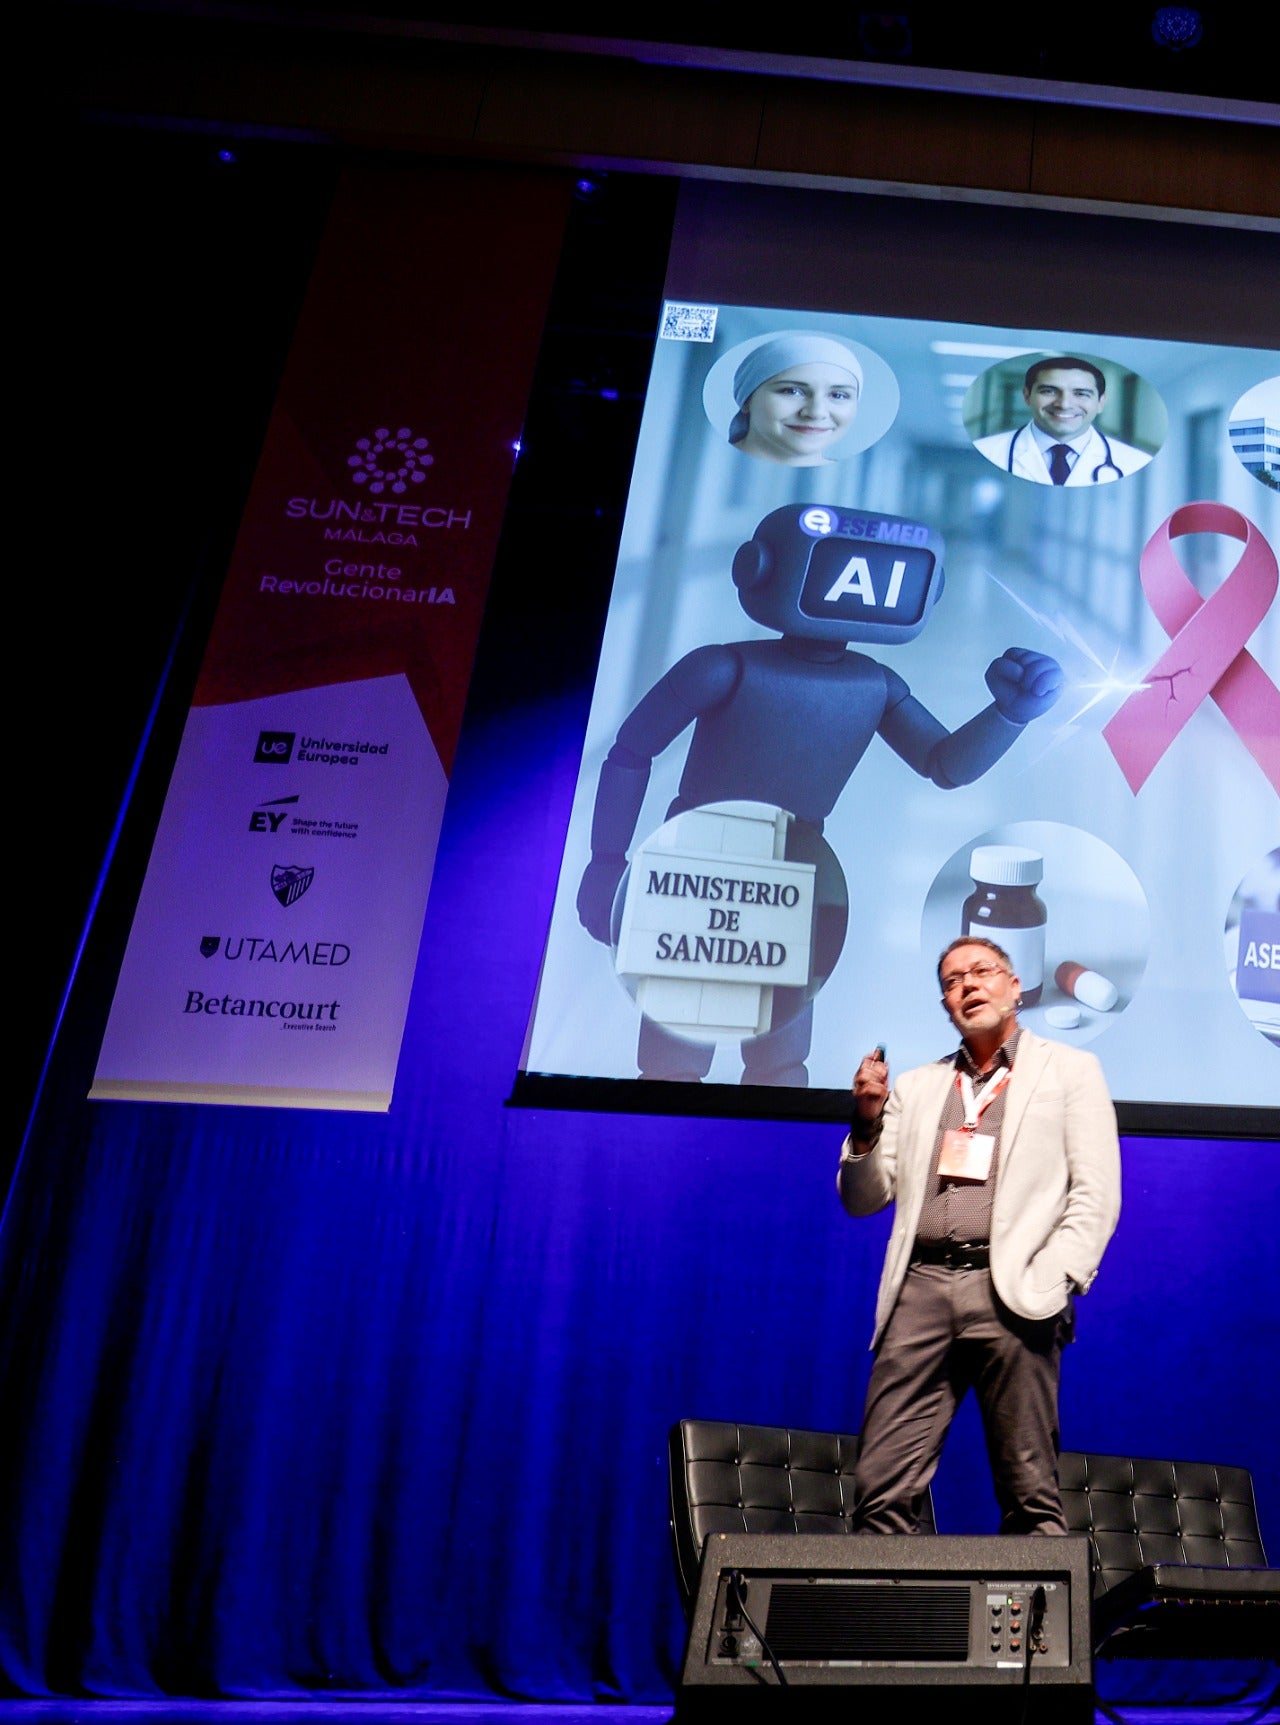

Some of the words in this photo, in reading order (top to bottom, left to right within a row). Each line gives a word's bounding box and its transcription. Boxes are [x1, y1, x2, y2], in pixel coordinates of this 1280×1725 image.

[285, 497, 472, 530] SUN&TECH
[838, 515, 929, 545] ESEMED
[324, 558, 402, 580] Gente
[824, 556, 906, 608] AI
[260, 575, 456, 605] RevolucionarIA
[297, 749, 359, 765] Europea
[301, 737, 389, 755] Universidad
[249, 811, 288, 832] EY
[291, 826, 310, 836] with
[311, 828, 357, 839] confidence
[293, 818, 318, 829] Shape
[319, 819, 333, 829] the
[335, 821, 358, 831] future
[645, 870, 800, 908] MINISTERIO
[707, 909, 740, 932] DE
[224, 937, 351, 966] UTAMED
[656, 933, 787, 968] SANIDAD
[183, 991, 341, 1020] Betancourt
[315, 1023, 336, 1032] Search
